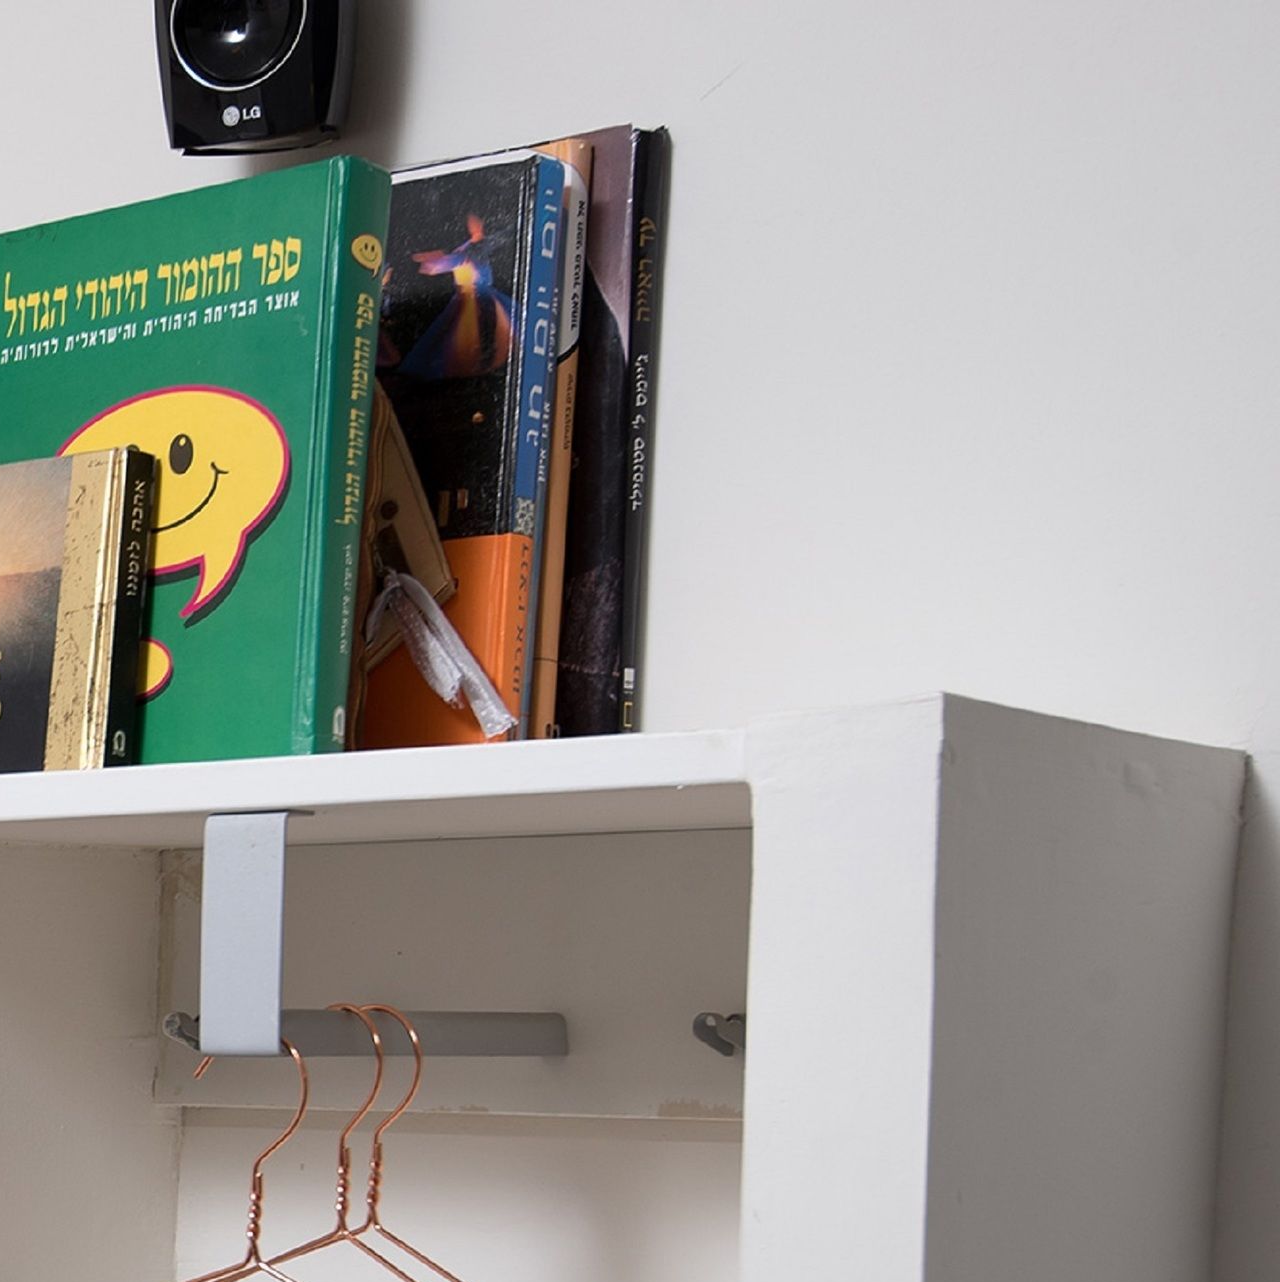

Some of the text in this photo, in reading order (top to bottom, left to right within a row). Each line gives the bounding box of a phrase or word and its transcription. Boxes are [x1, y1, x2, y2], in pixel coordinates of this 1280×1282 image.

[243, 106, 261, 120] LG
[577, 200, 585, 217] אל
[3, 237, 302, 339] ספר ההומור היהודי הגדול
[636, 216, 656, 322] עד ראייה
[143, 311, 197, 338] היהודית
[203, 299, 257, 326] הבדיחה
[264, 290, 300, 314] אוצר
[356, 292, 375, 330] ספר
[526, 188, 558, 448] יום יום חג
[570, 292, 580, 332] לאחור
[64, 321, 137, 353] והישראלית
[350, 335, 371, 401] ההומור
[634, 353, 649, 407] ג'יימס
[347, 407, 366, 467] היהודי
[335, 472, 360, 526] הגדול
[628, 437, 645, 512] סטנפילד
[125, 479, 146, 598] אהבה לזמננו
